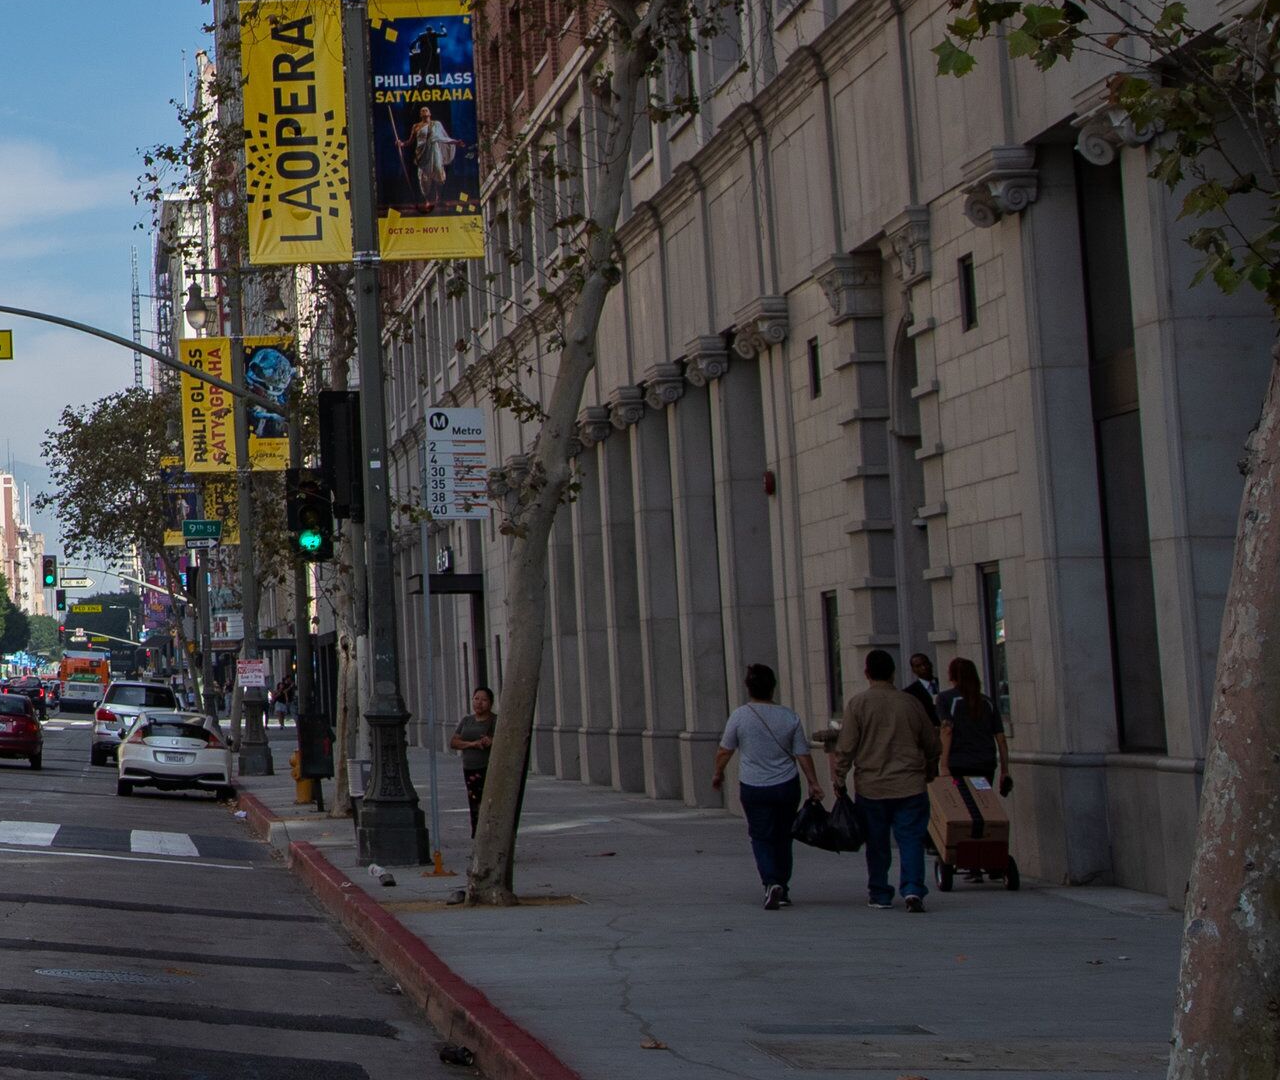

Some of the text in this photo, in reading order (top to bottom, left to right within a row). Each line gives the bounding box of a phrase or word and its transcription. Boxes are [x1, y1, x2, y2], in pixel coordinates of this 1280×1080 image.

[374, 72, 473, 88] PHILIP GLASS
[375, 89, 474, 104] SATYAGRAHA
[388, 227, 403, 235] OCT
[422, 226, 438, 234] NOV
[189, 348, 208, 463] PHILIP GLSS
[432, 415, 446, 428] M
[452, 427, 482, 436] Metro
[429, 442, 436, 452] 2
[430, 455, 438, 465] 4
[431, 467, 445, 477] 30
[431, 480, 445, 489] 35
[431, 493, 445, 502] 38
[432, 505, 447, 515] 40
[189, 524, 204, 533] 9th
